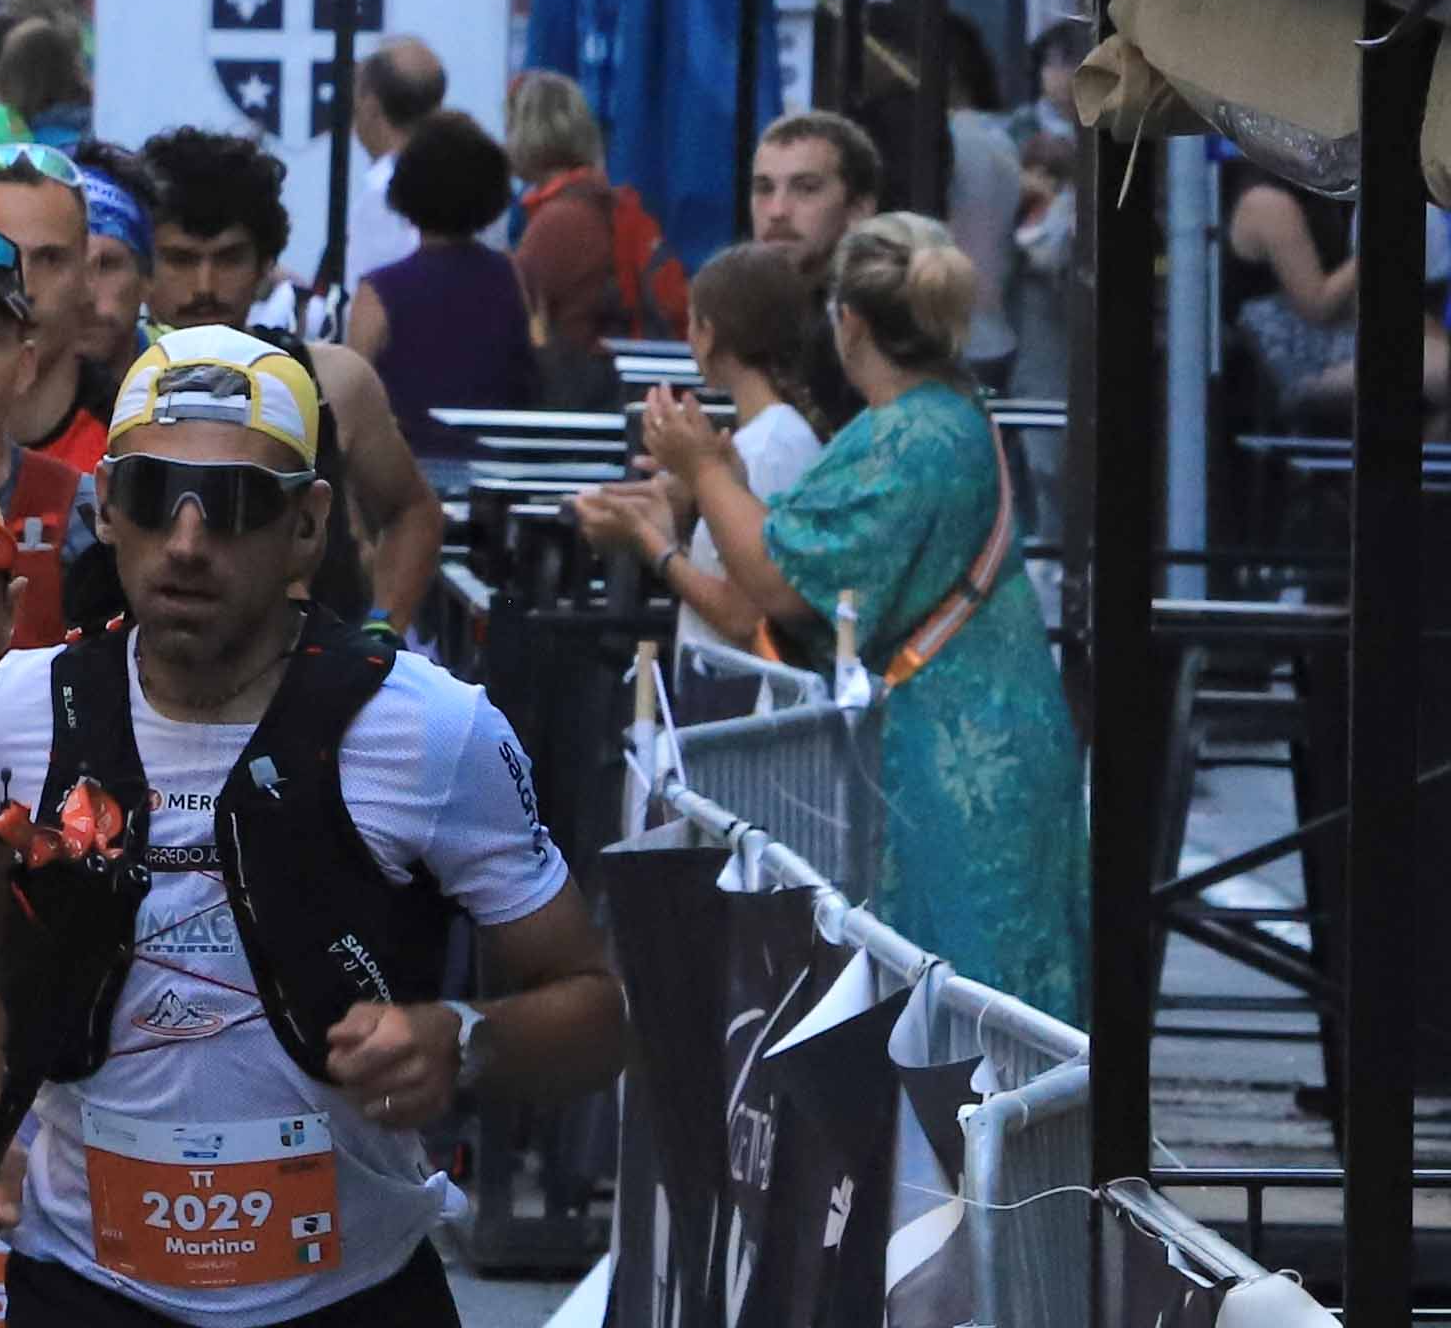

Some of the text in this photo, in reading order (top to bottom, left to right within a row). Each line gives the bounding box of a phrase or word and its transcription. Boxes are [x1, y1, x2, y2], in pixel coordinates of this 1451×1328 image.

[188, 1170, 215, 1189] TT
[141, 1189, 274, 1233] 2029
[165, 1236, 257, 1256] Martina
